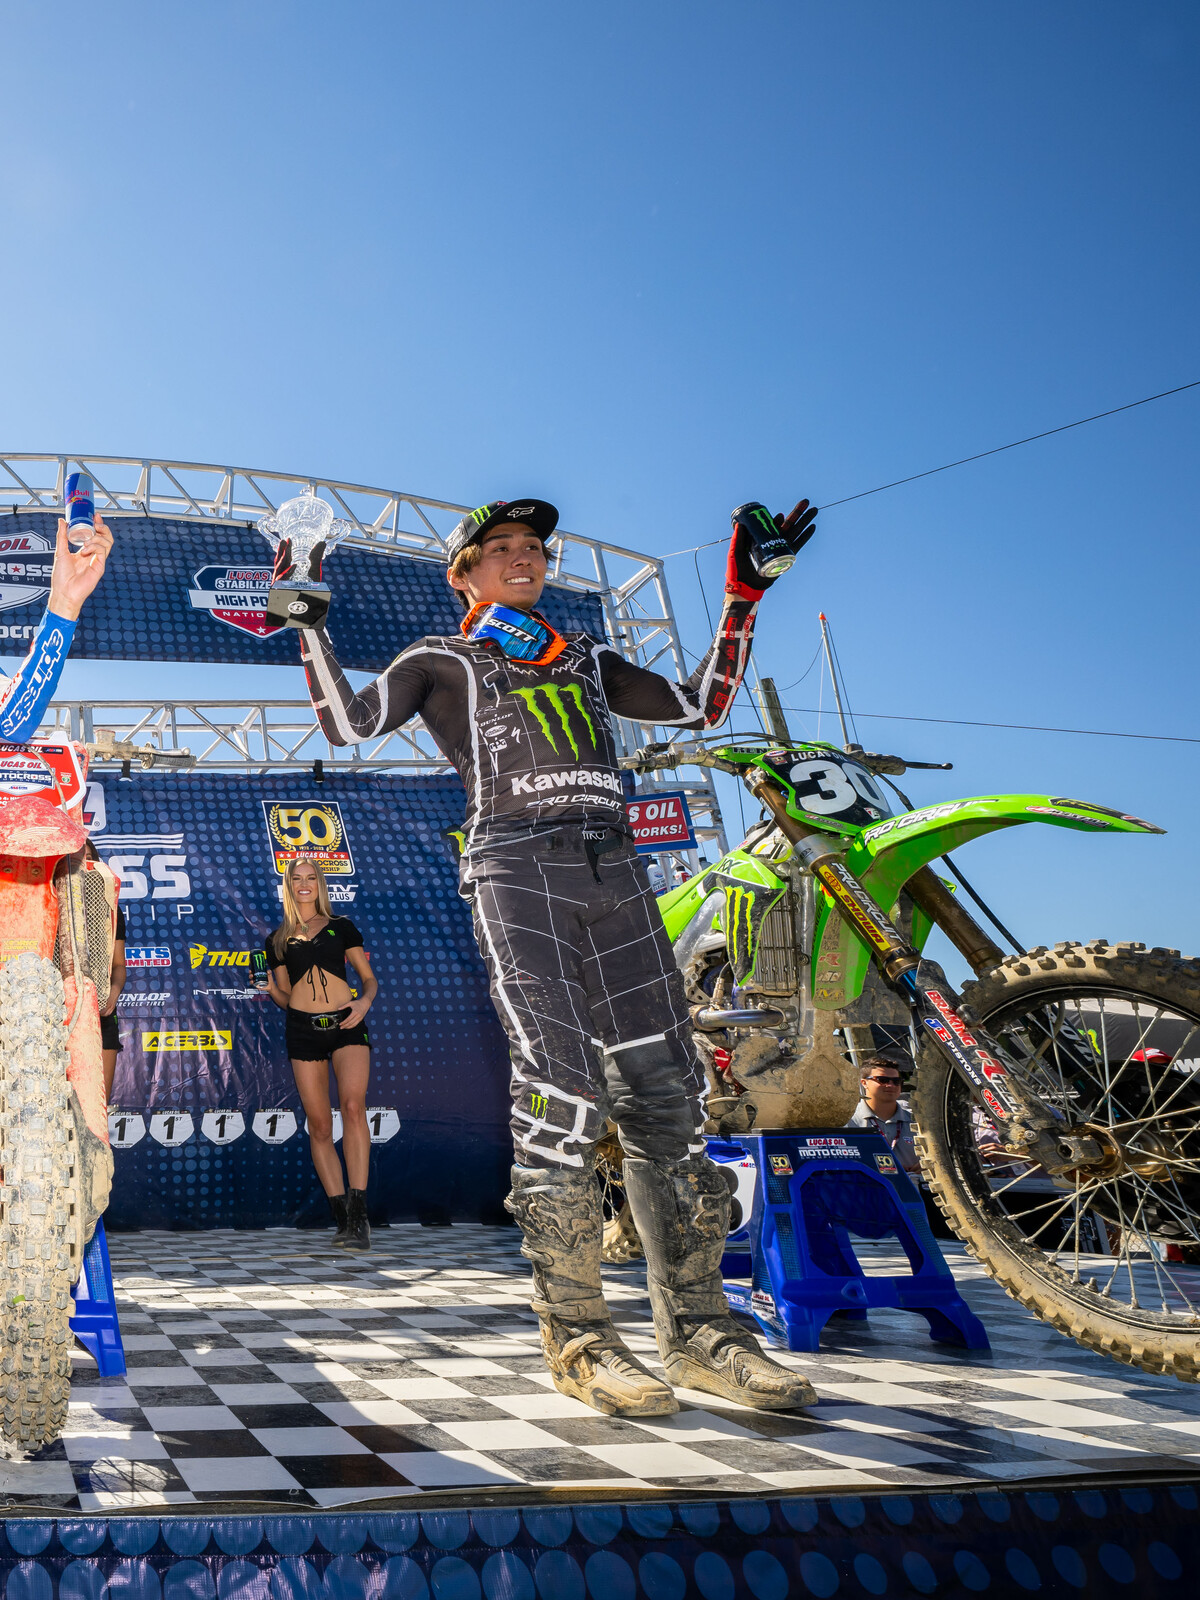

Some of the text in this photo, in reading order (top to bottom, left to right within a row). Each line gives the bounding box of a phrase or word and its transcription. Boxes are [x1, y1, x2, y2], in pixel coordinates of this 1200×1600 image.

[74, 489, 90, 497] Bull
[217, 579, 271, 589] STABILIZE
[228, 571, 269, 580] LUCAS
[215, 595, 248, 606] HIGH
[487, 618, 538, 642] SCOTT
[726, 645, 737, 662] RK
[480, 713, 513, 727] DUNLOP
[790, 750, 831, 762] LUCAS
[511, 770, 624, 796] Kawasaki
[790, 760, 890, 814] 30
[526, 794, 622, 810] PRO CIRCUIT
[645, 802, 678, 821] OIL
[278, 808, 336, 846] 50
[632, 824, 683, 839] WORKS!
[832, 862, 905, 943] PRO CIRCUIT
[841, 894, 885, 944] SHOWA
[126, 948, 169, 959] RTS
[208, 951, 250, 966] THO
[118, 992, 170, 1001] UNLOP
[925, 990, 978, 1046] BRAKING
[924, 1018, 952, 1042] JE
[145, 1036, 228, 1048] ACERBIS
[946, 1041, 982, 1085] PISTONS
[114, 1117, 134, 1141] 1ST
[163, 1115, 182, 1139] 1ST
[215, 1114, 234, 1138] 1ST
[266, 1114, 285, 1137] 1ST
[370, 1112, 389, 1136] 1ST
[772, 1156, 788, 1167] 50
[878, 1155, 892, 1166] 50
